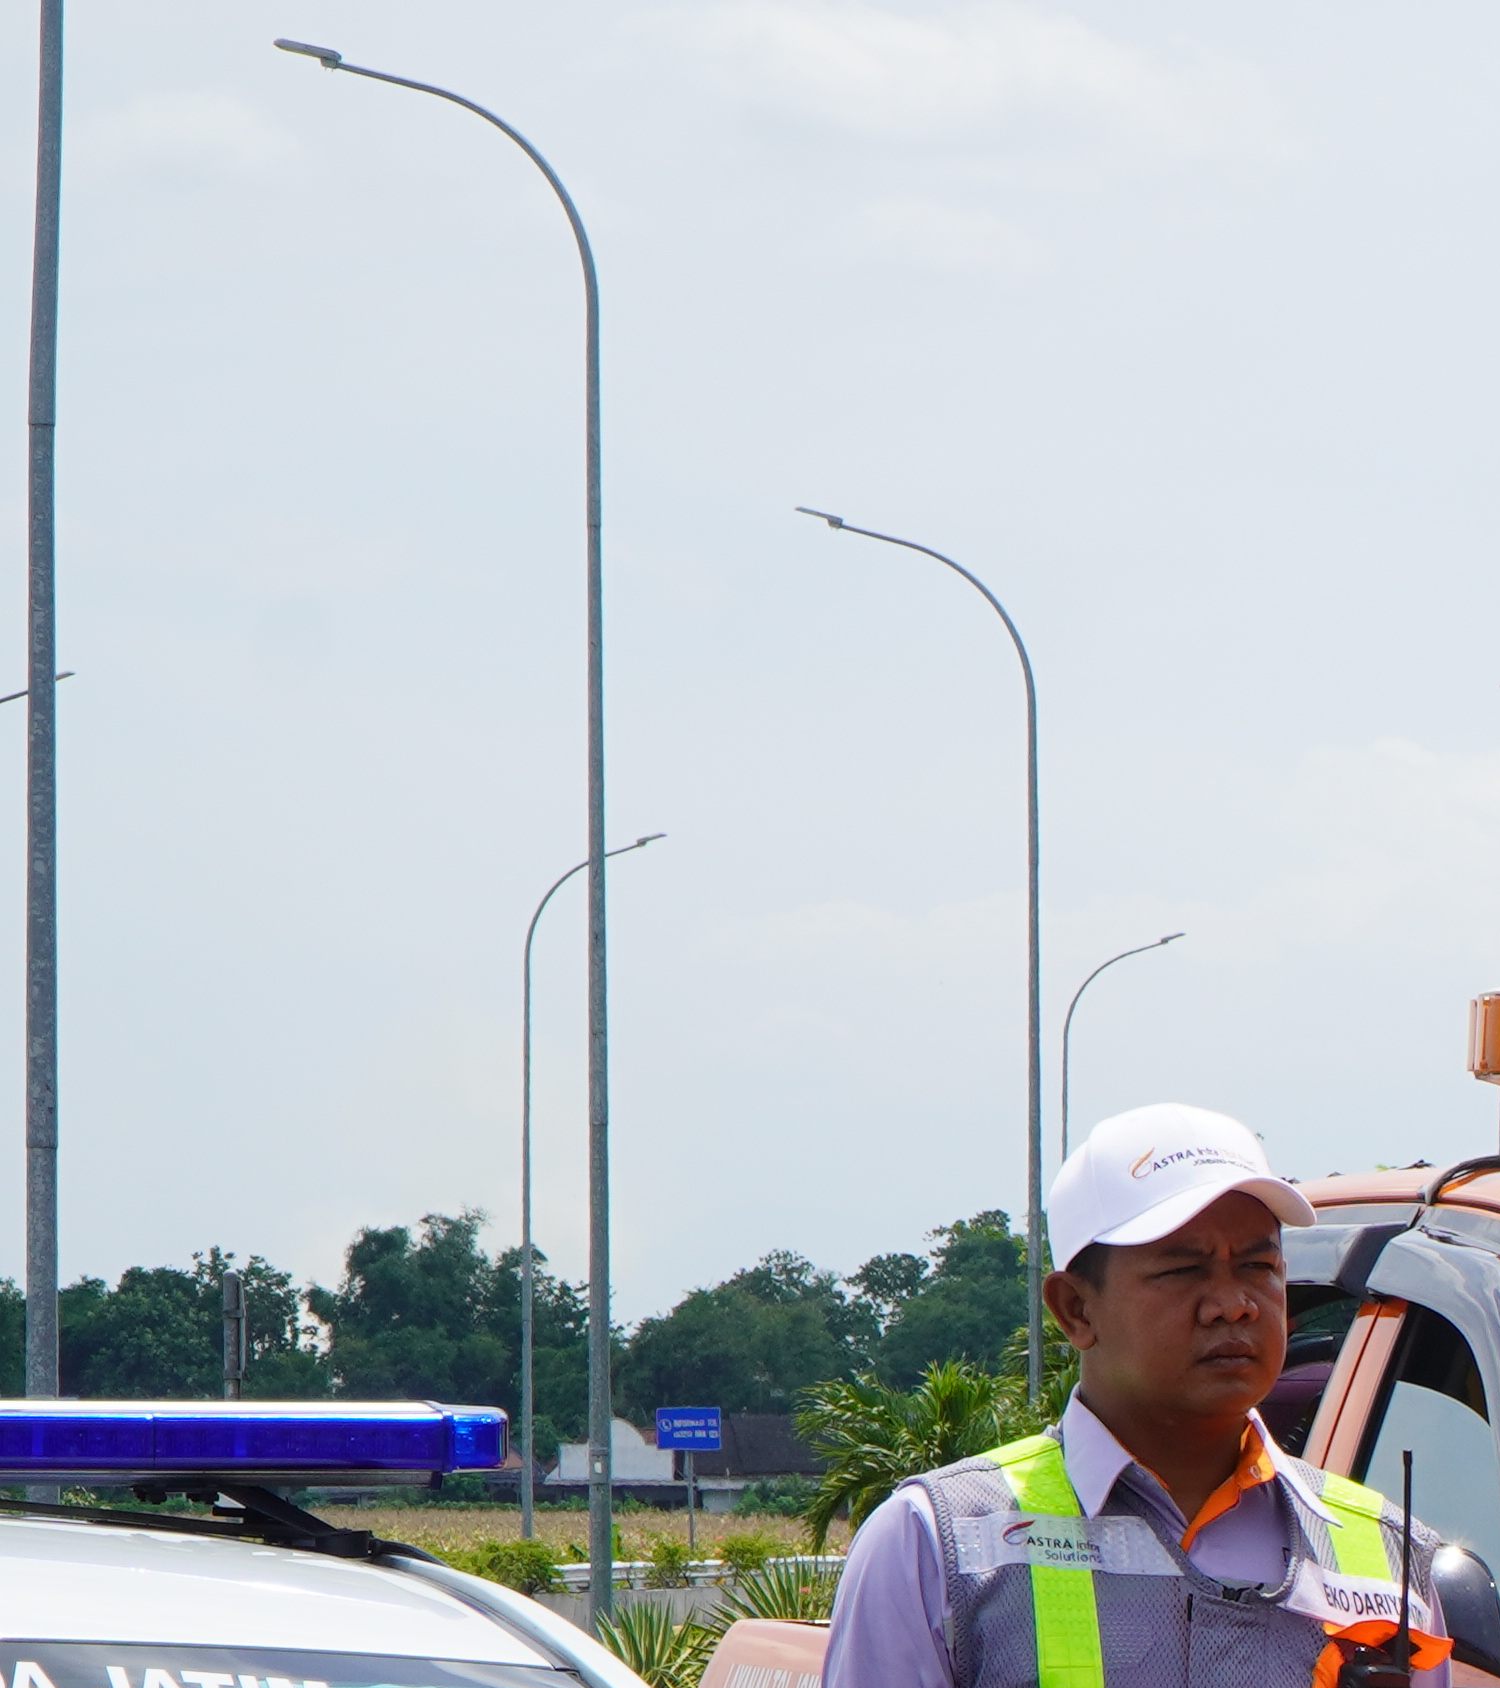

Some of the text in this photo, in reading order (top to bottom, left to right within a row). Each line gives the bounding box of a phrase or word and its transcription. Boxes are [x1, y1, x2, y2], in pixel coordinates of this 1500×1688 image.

[1153, 1149, 1195, 1172] ASTRA
[1026, 1535, 1073, 1549] ASTRA
[1322, 1582, 1351, 1613] EKO
